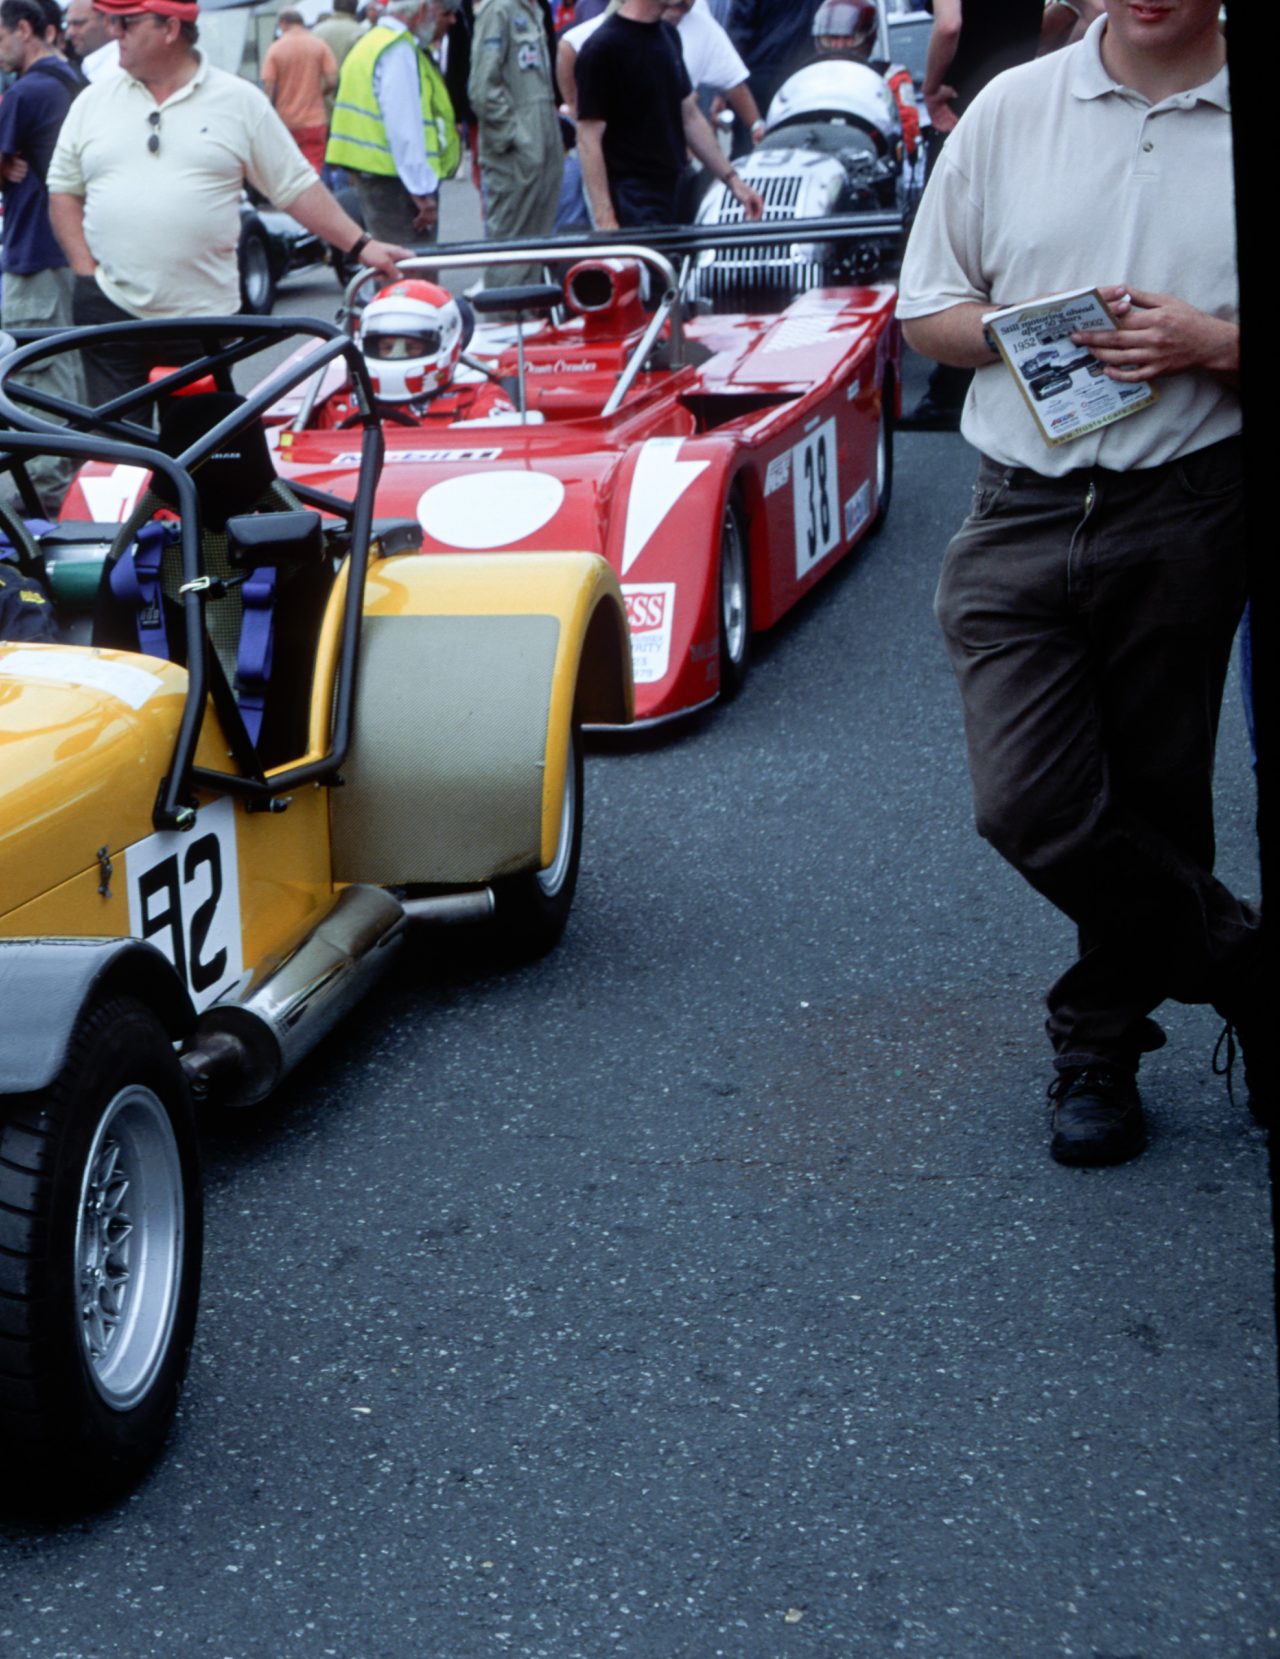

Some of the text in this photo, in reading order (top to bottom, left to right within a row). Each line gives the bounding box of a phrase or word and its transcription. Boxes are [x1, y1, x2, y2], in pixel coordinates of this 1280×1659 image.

[1000, 322, 1020, 335] Still
[1021, 312, 1064, 329] motoring
[1066, 304, 1095, 317] ahead
[1021, 315, 1083, 337] after 50 years
[1081, 318, 1105, 330] 2002
[1013, 337, 1038, 354] 1952
[339, 451, 451, 463] Mbil
[804, 434, 831, 559] 38
[138, 832, 228, 993] 92
